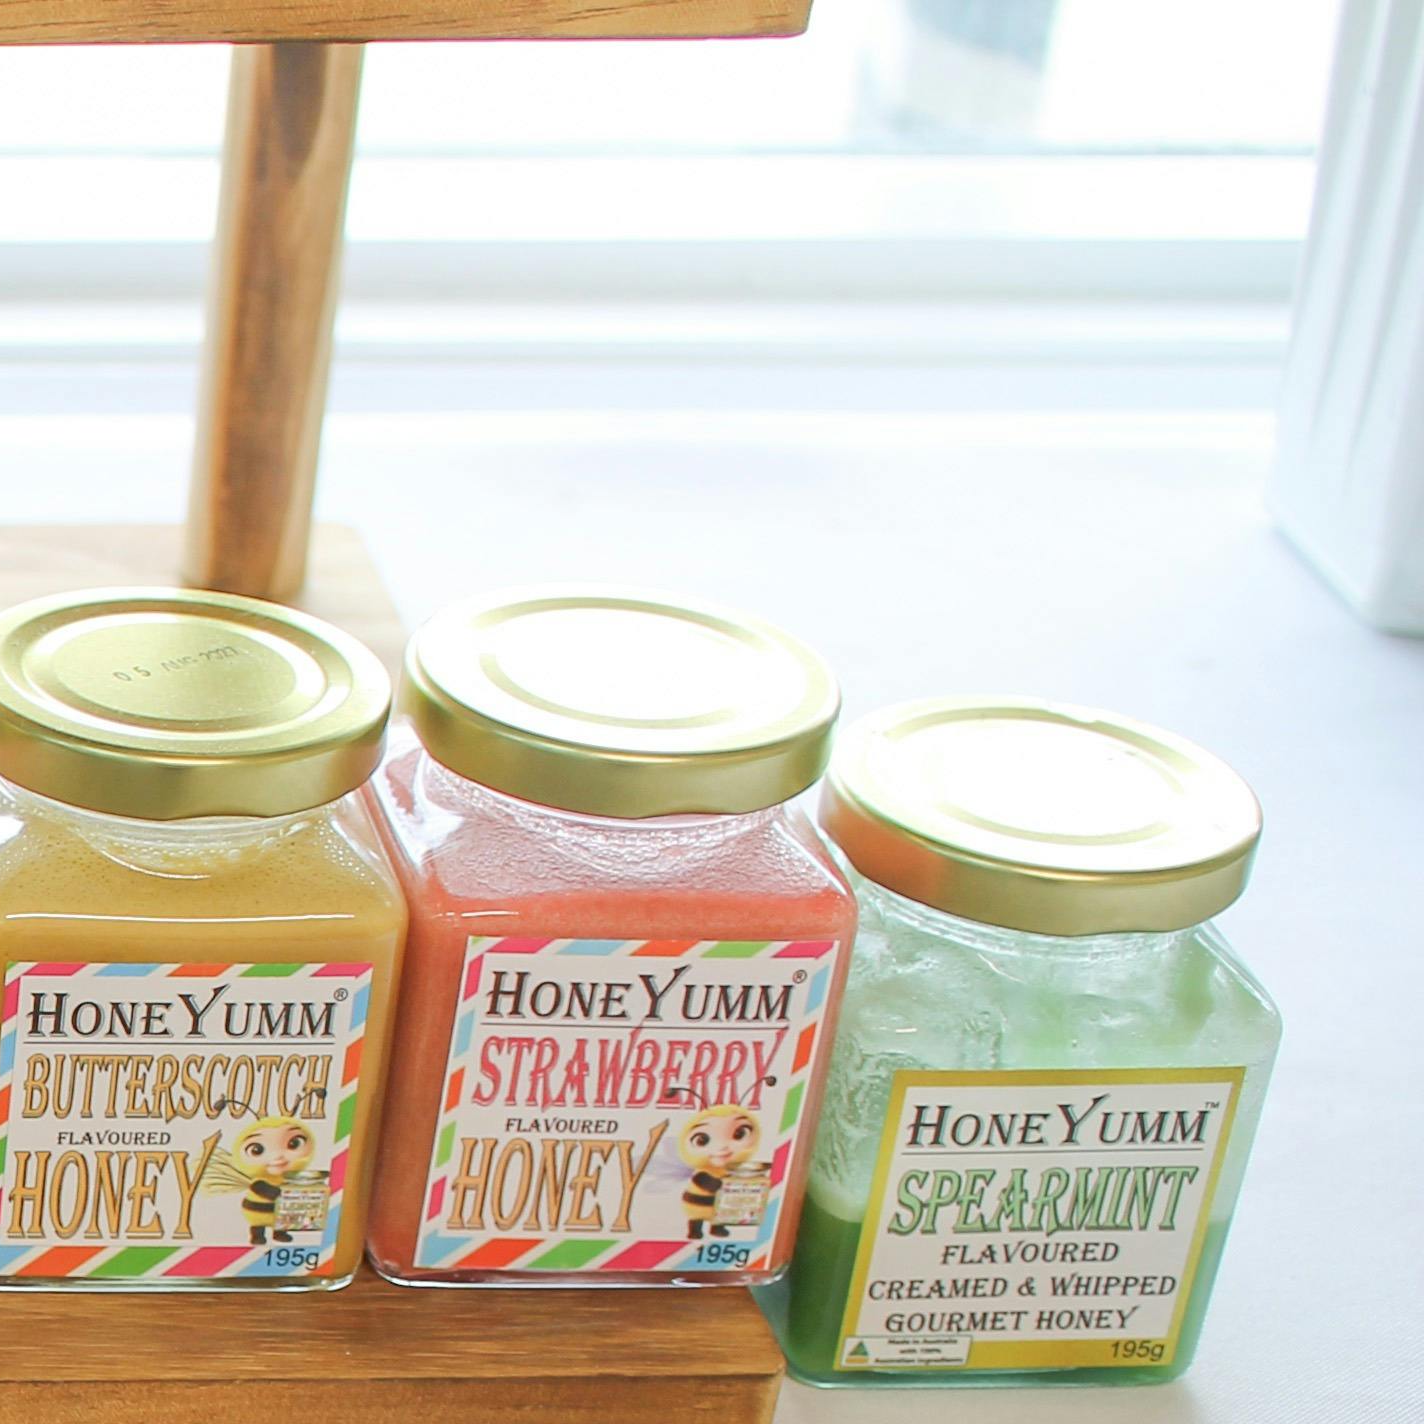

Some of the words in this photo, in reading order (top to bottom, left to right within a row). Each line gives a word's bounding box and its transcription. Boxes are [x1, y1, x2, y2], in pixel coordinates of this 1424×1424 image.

[471, 1026, 788, 1111] STRAWBERRY
[22, 1053, 329, 1122] BUTTERSCOTCH
[57, 1131, 170, 1146] FLAVOURED
[505, 1118, 619, 1133] FLAVOURED
[6, 1129, 222, 1241] HONEY
[446, 1119, 670, 1232] HONEY
[888, 1165, 1199, 1236] SPEARMINT
[263, 1247, 320, 1270] 195g
[693, 1244, 750, 1267] 195g
[941, 1241, 1119, 1265] FLAVOURED
[868, 1277, 1010, 1300] CREAMED
[1018, 1279, 1035, 1299] &
[1050, 1274, 1176, 1297] WHIPPED
[885, 1310, 1028, 1333] GOURMET
[1035, 1304, 1139, 1330] HONEY
[1111, 1340, 1165, 1361] 195g
